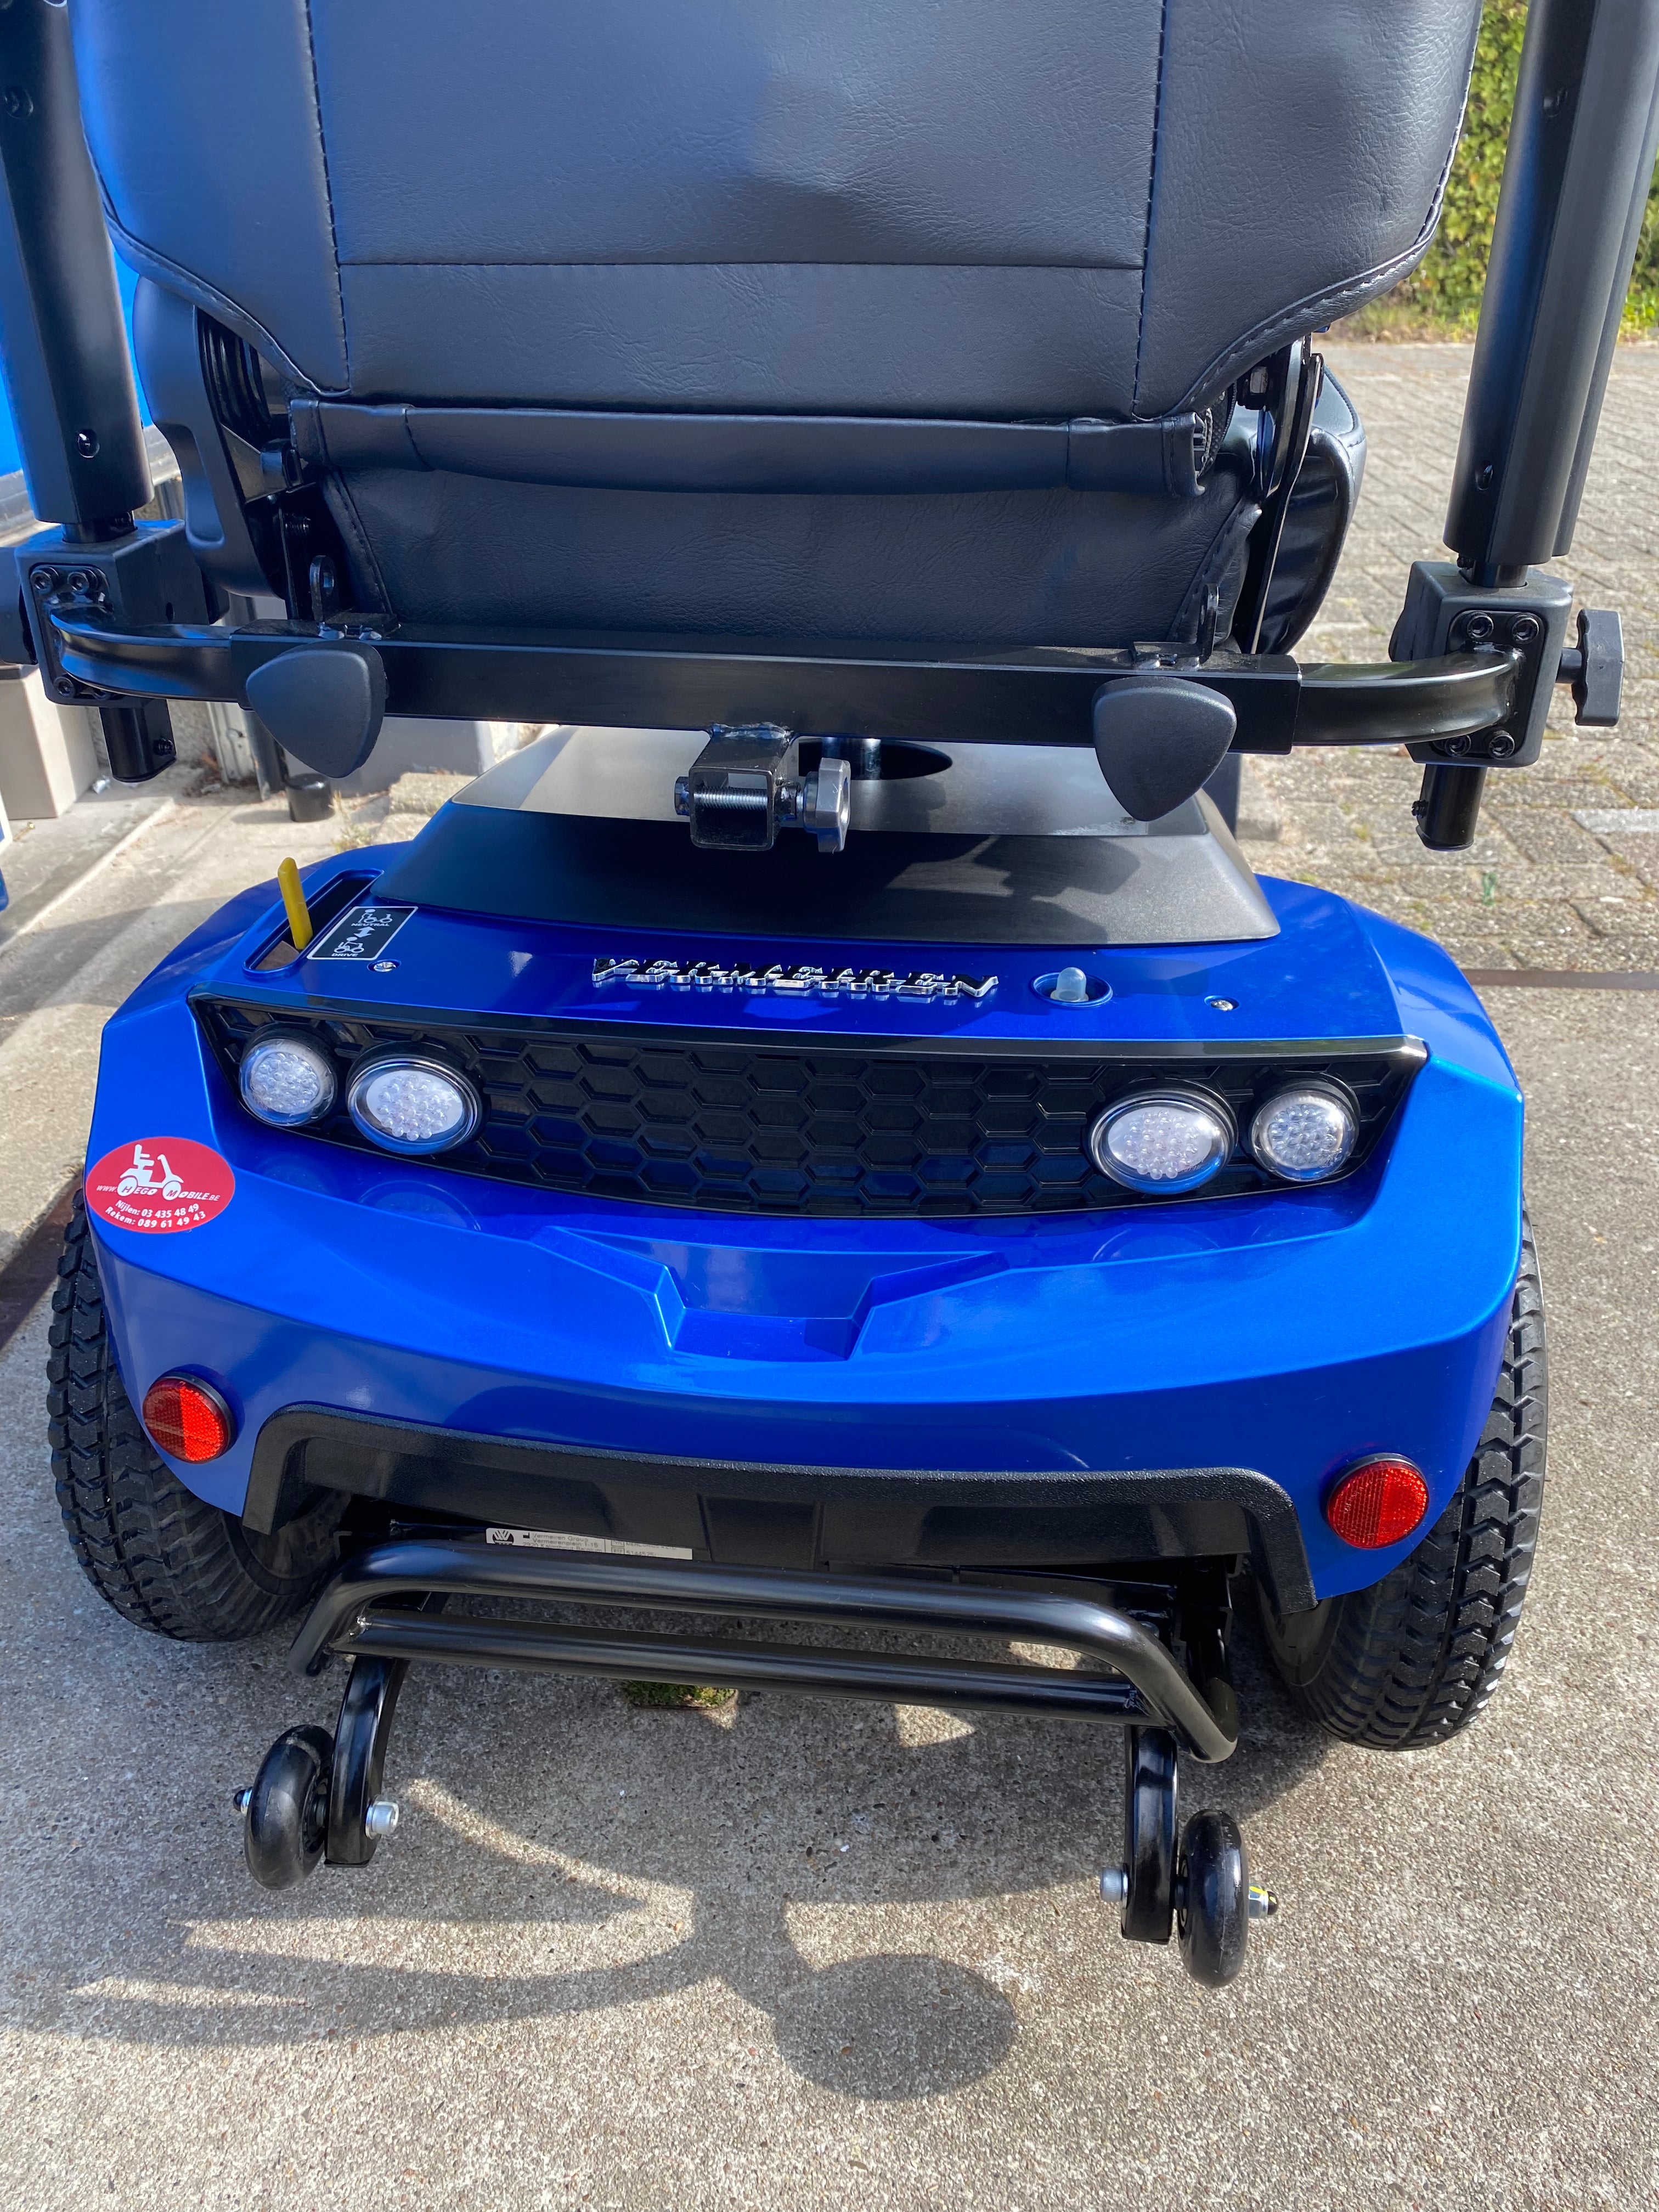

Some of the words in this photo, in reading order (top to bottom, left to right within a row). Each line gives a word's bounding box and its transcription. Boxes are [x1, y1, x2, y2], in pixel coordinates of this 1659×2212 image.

[592, 957, 999, 997] VERMEIREN
[105, 1206, 136, 1225] Rekem:
[137, 1218, 157, 1228] 089
[160, 1220, 172, 1228] 61
[176, 1216, 190, 1226] 49
[193, 1211, 206, 1221] 43
[115, 1200, 140, 1215] Nijlen:
[141, 1209, 153, 1217] 03
[154, 1210, 172, 1218] 435
[174, 1207, 187, 1217] 48
[188, 1203, 199, 1213] 49
